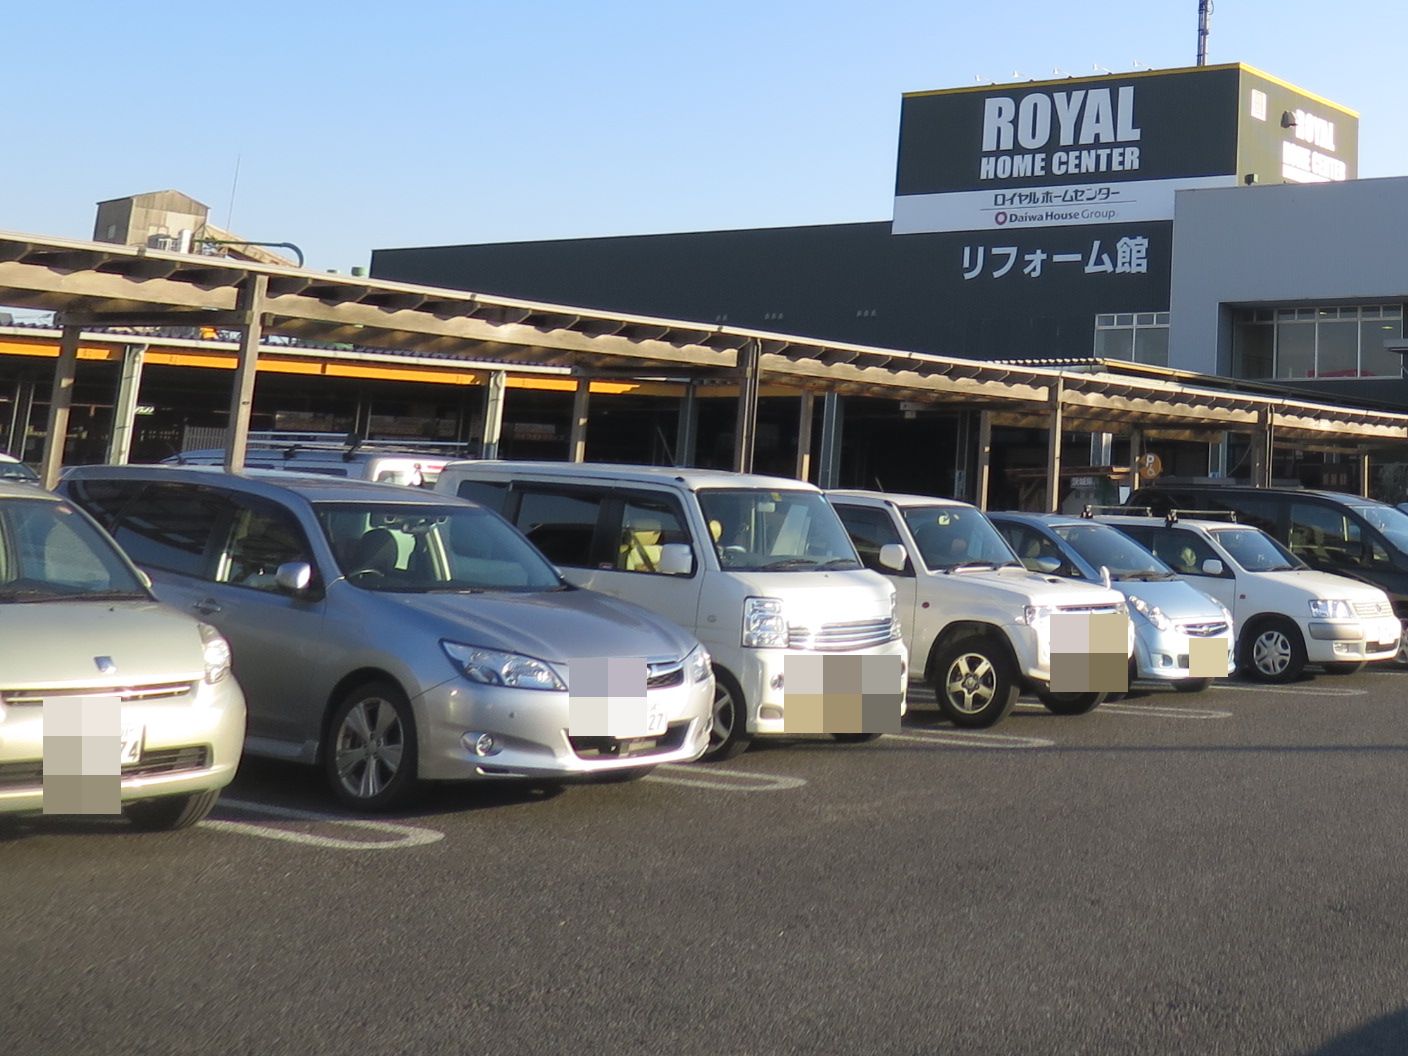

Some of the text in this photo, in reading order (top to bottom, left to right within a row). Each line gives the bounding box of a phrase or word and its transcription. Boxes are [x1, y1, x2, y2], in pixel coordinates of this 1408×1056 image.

[982, 86, 1141, 152] ROYAL
[980, 147, 1141, 180] HOME CENTER
[994, 187, 1120, 206] ロイヤルホームセンター
[1009, 209, 1116, 223] Daiwa House Group
[962, 236, 1149, 280] リフォーム館
